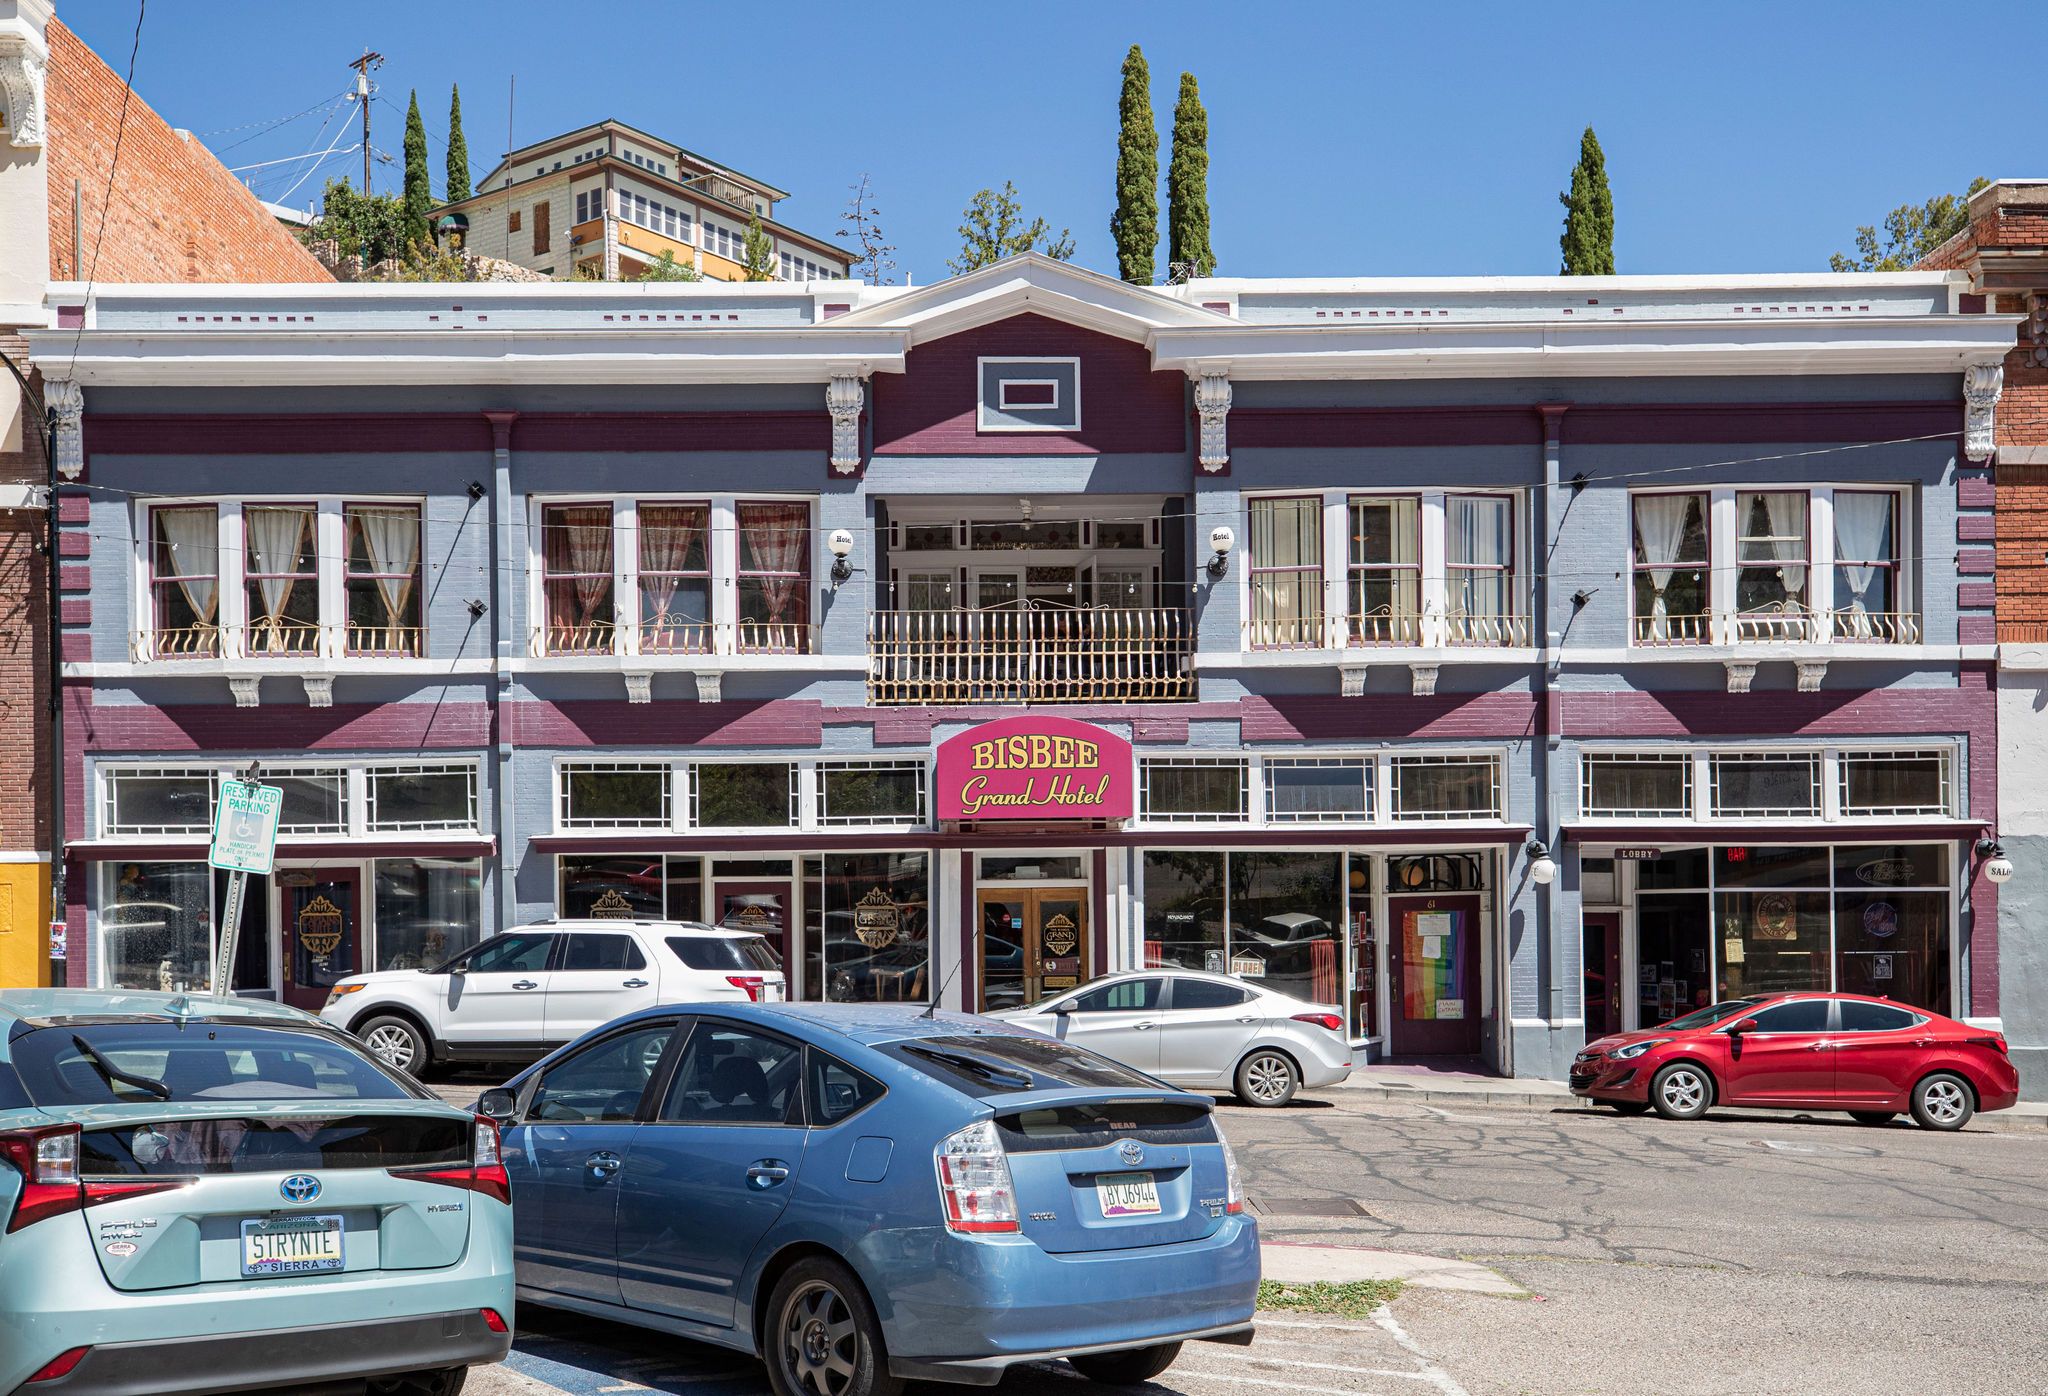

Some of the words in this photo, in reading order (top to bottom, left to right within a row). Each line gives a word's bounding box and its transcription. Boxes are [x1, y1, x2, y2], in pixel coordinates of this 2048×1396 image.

[836, 535, 852, 544] Hotel
[971, 734, 1099, 770] BISBEE
[225, 785, 277, 803] RESERVED
[961, 775, 1035, 815] Grand
[1031, 774, 1110, 806] Hotel
[228, 798, 271, 815] PARKING
[1622, 850, 1653, 858] LOBBY
[1727, 847, 1745, 862] BAR
[1427, 900, 1436, 909] 61
[1046, 931, 1075, 941] GRAND
[1763, 924, 1779, 937] PALE
[1233, 962, 1263, 975] CLOSED
[1106, 1183, 1155, 1206] BYJ6944
[253, 1230, 334, 1259] STRYNTE
[271, 1262, 320, 1272] SIERRA
